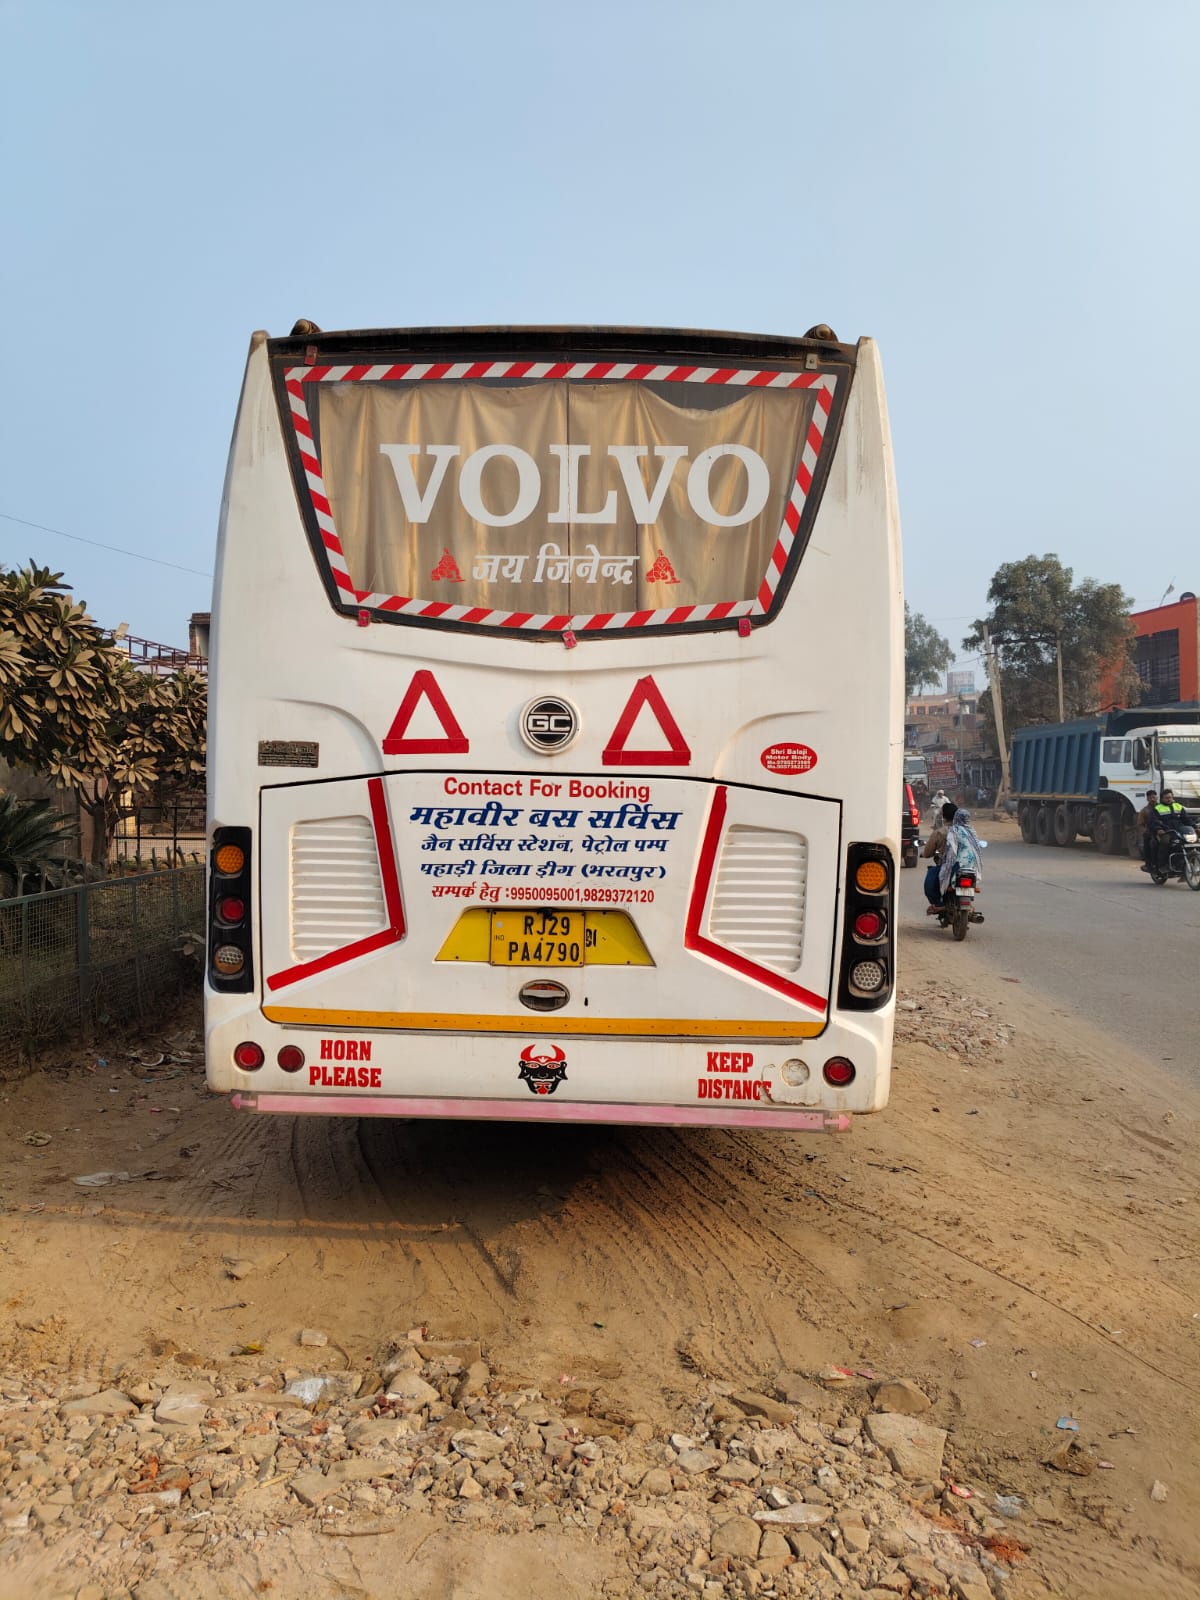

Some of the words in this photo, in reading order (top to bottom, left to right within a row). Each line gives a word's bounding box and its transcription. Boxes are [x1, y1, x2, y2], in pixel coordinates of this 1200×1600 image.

[379, 443, 770, 528] VOLVO
[472, 554, 529, 584] जय
[532, 543, 639, 585] जिनेन्द्र
[527, 714, 571, 732] GC
[444, 777, 523, 797] Contact
[529, 779, 563, 798] For
[568, 780, 651, 803] Booking
[409, 801, 523, 830] महावीर
[528, 808, 583, 828] बस
[587, 803, 683, 831] सर्विस
[421, 833, 453, 852] जैन
[458, 833, 514, 852] सर्विस
[518, 834, 574, 854] स्टेशन,
[581, 835, 629, 855] पेट्रोल
[634, 839, 668, 853] पम्प
[480, 859, 532, 877] जिला
[581, 863, 667, 882] (भरतपुर)
[431, 881, 477, 899] सम्पर्क
[479, 882, 503, 903] हेतु
[524, 915, 570, 936] RJ29
[508, 941, 580, 962] PA4790
[320, 1040, 372, 1061] HORN
[707, 1052, 754, 1073] KEEP
[309, 1066, 382, 1088] PLEASE
